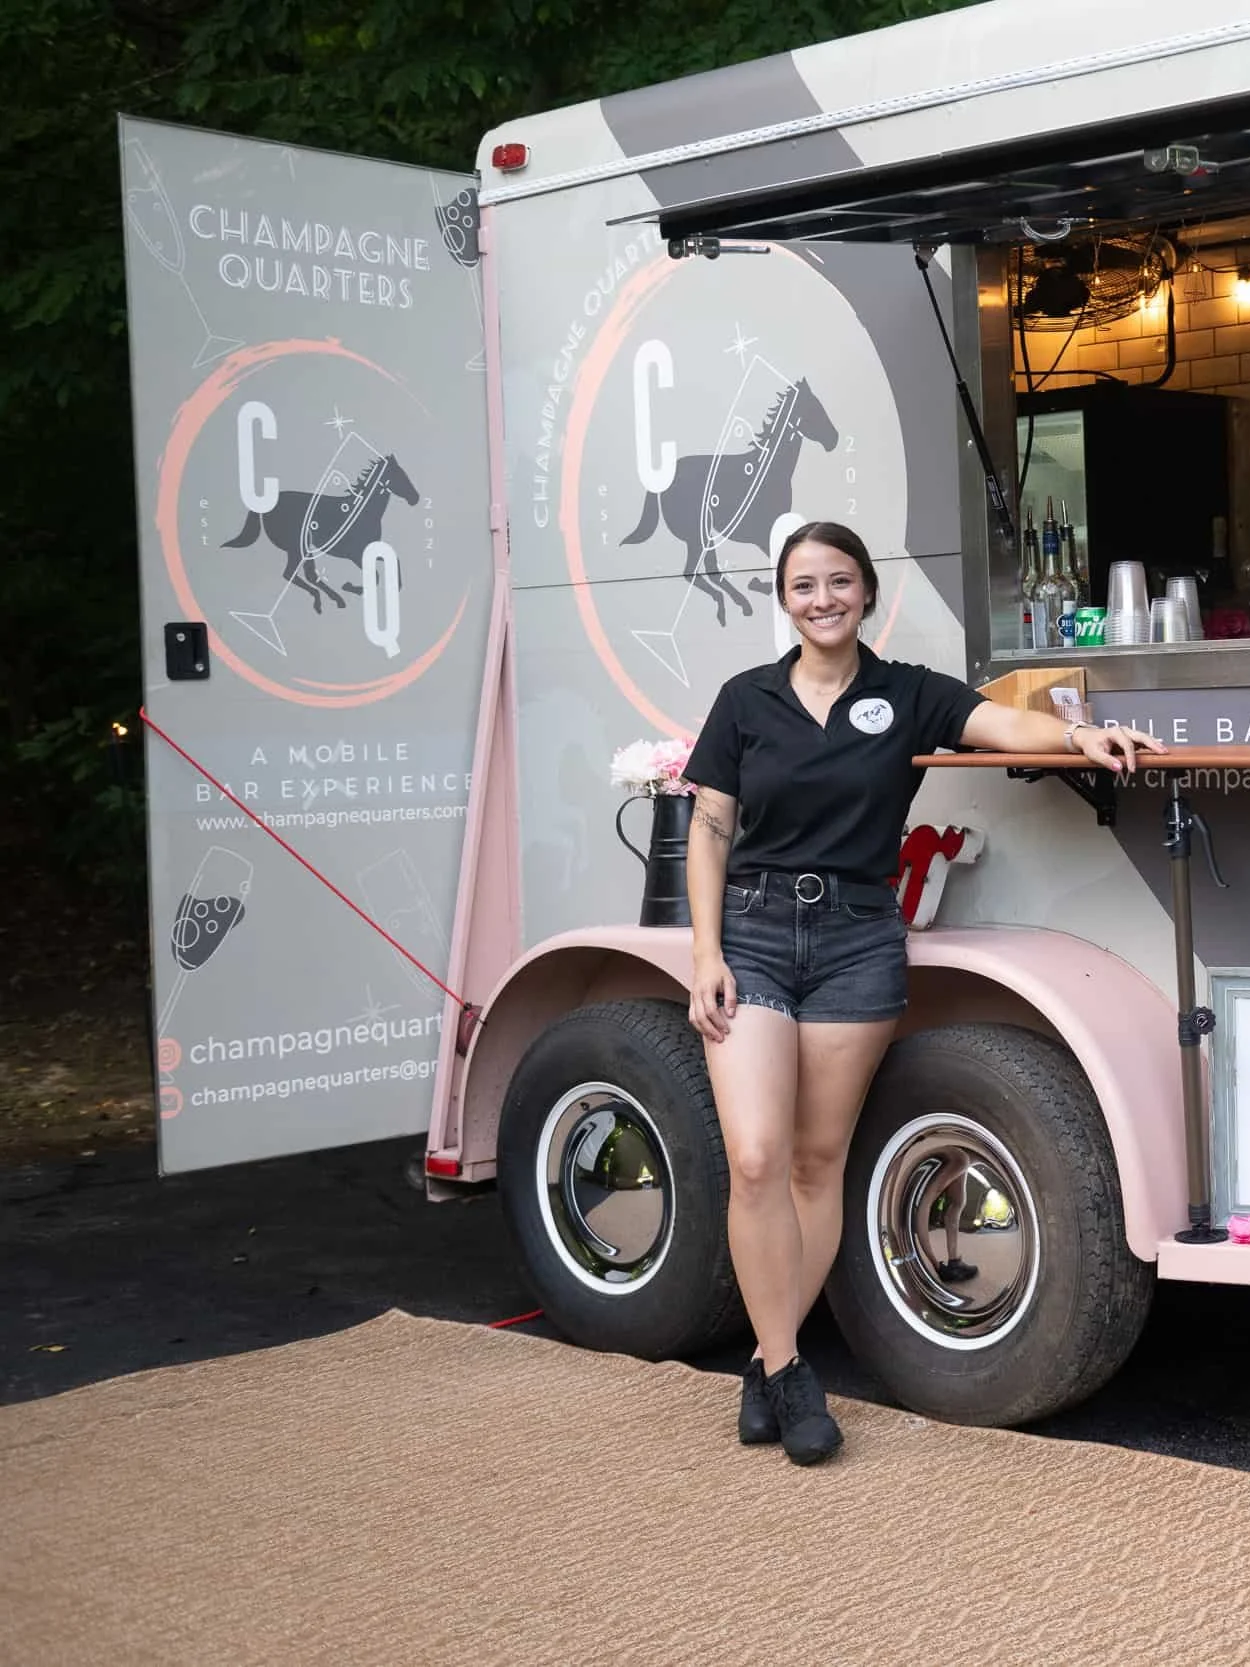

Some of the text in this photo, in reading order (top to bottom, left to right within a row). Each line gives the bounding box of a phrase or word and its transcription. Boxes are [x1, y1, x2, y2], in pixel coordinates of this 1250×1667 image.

[189, 204, 430, 271] CHAMPAGNE
[219, 253, 413, 309] QUARTERS
[237, 401, 277, 513] C
[533, 319, 585, 528] CHAMPAGNE
[634, 339, 677, 494] C
[845, 435, 857, 516] 202
[362, 541, 401, 659] Q
[196, 782, 259, 802] BAR
[251, 743, 409, 765] A MOBILE
